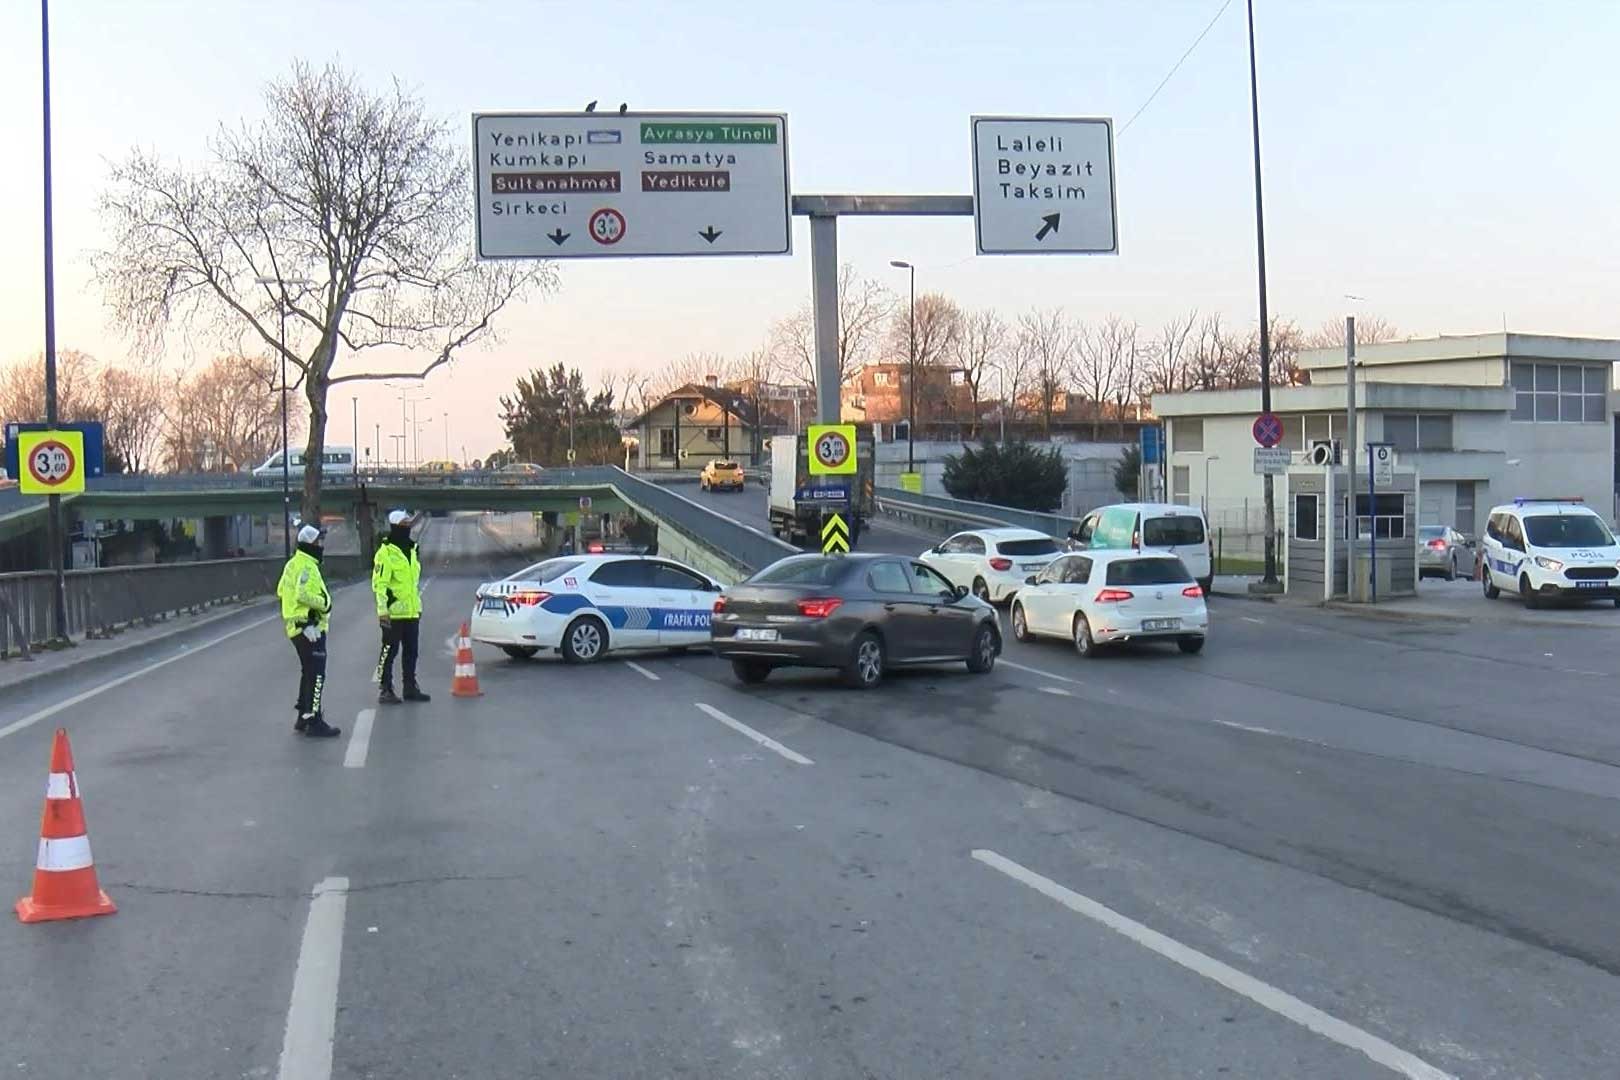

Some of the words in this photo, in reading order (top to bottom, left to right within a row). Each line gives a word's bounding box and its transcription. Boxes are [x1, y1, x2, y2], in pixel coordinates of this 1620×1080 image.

[491, 131, 582, 149] Yenikapı
[644, 127, 714, 142] Avrasya
[720, 127, 772, 140] Tüneli
[996, 135, 1062, 152] Laleli
[490, 152, 586, 168] Kumkapı
[644, 151, 736, 168] Samatya
[998, 159, 1093, 179] Beyazıt
[496, 176, 616, 191] Sultanahmet
[647, 174, 726, 188] Yedikule
[999, 183, 1086, 200] Taksim
[492, 201, 567, 215] Sirkeci
